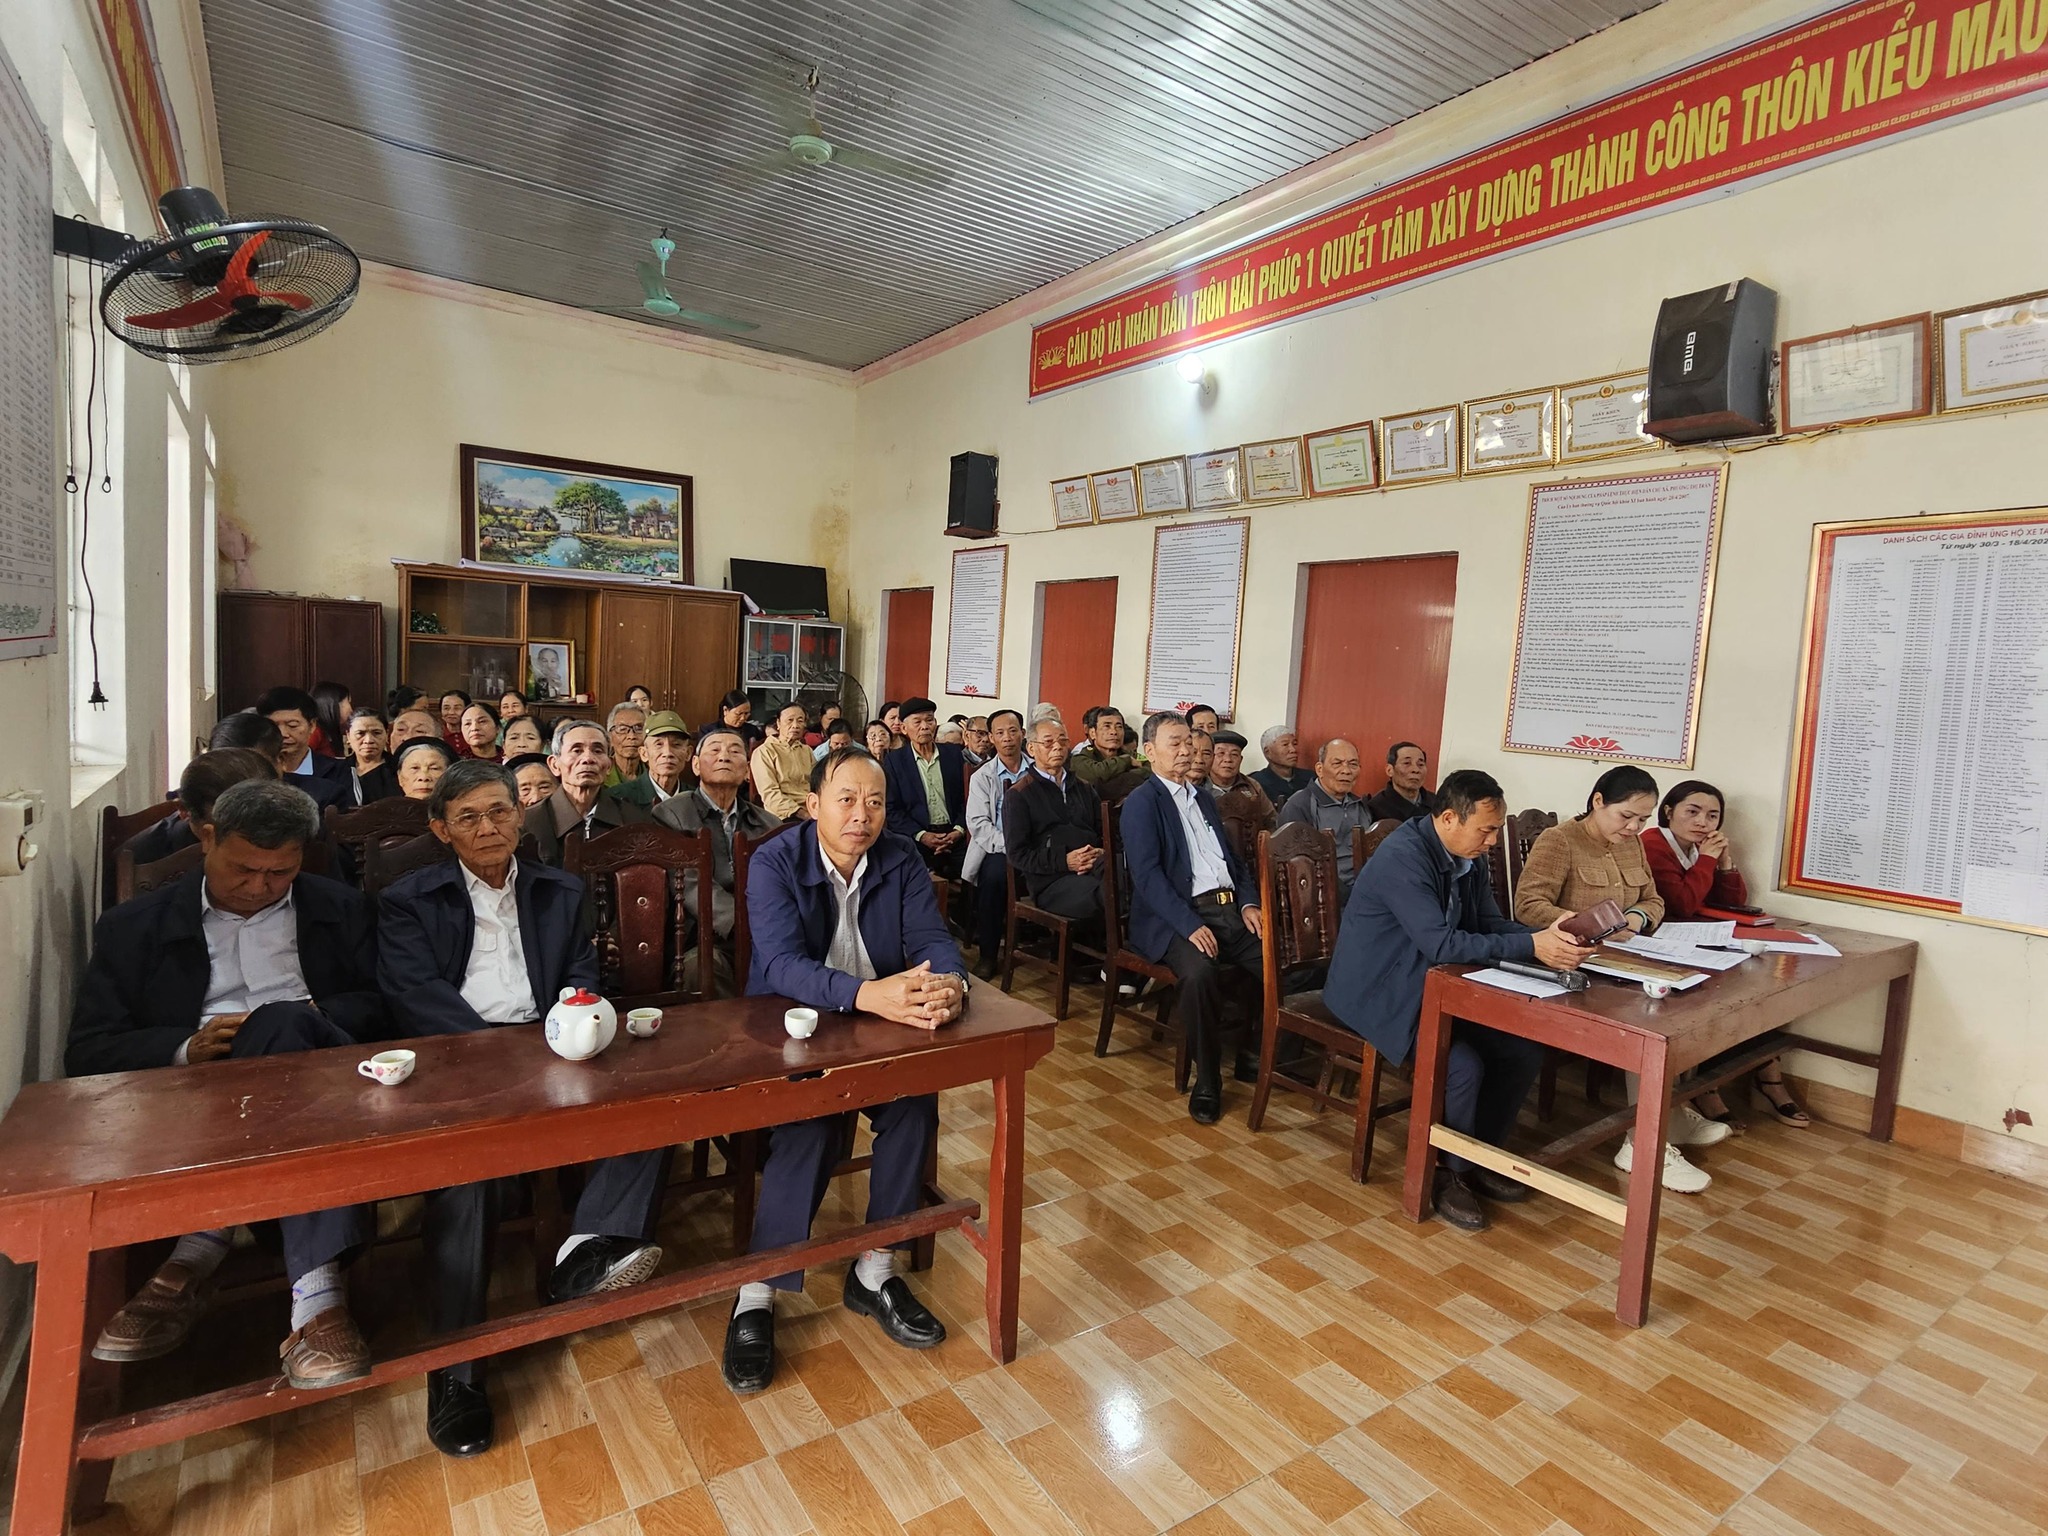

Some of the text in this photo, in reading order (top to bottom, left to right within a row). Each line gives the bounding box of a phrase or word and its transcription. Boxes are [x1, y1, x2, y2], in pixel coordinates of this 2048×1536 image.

[1066, 337, 1088, 369] CÁN
[1090, 329, 1106, 366] BỘ
[1107, 324, 1122, 356] VÀ
[1124, 309, 1159, 352] NHÂN
[1161, 294, 1189, 340] DÂN
[1191, 278, 1228, 326] THÔN
[1230, 260, 1255, 314] HẢI
[1257, 249, 1301, 306] PHÚC
[1306, 250, 1314, 289] 1
[1319, 214, 1376, 287] QUYẾT
[1381, 205, 1423, 264] TÂM
[1427, 184, 1475, 248] XÂY
[1476, 162, 1542, 236] DỰNG
[1550, 127, 1640, 205] THÀNH
[1644, 97, 1732, 177] CÔNG
[1740, 56, 1834, 147] THÔN
[1841, 2, 1940, 112] KIỂU
[1883, 534, 1906, 545] DANH
[1906, 531, 1929, 544] SÁCH
[1929, 530, 1948, 541] CÁC
[1950, 531, 1965, 541] GIA
[1967, 529, 1988, 540] ĐÌNH
[2010, 527, 2024, 538] HỘ
[2026, 528, 2038, 536] XE
[1954, 541, 1977, 551] ngày
[1979, 540, 1999, 549] 30/3
